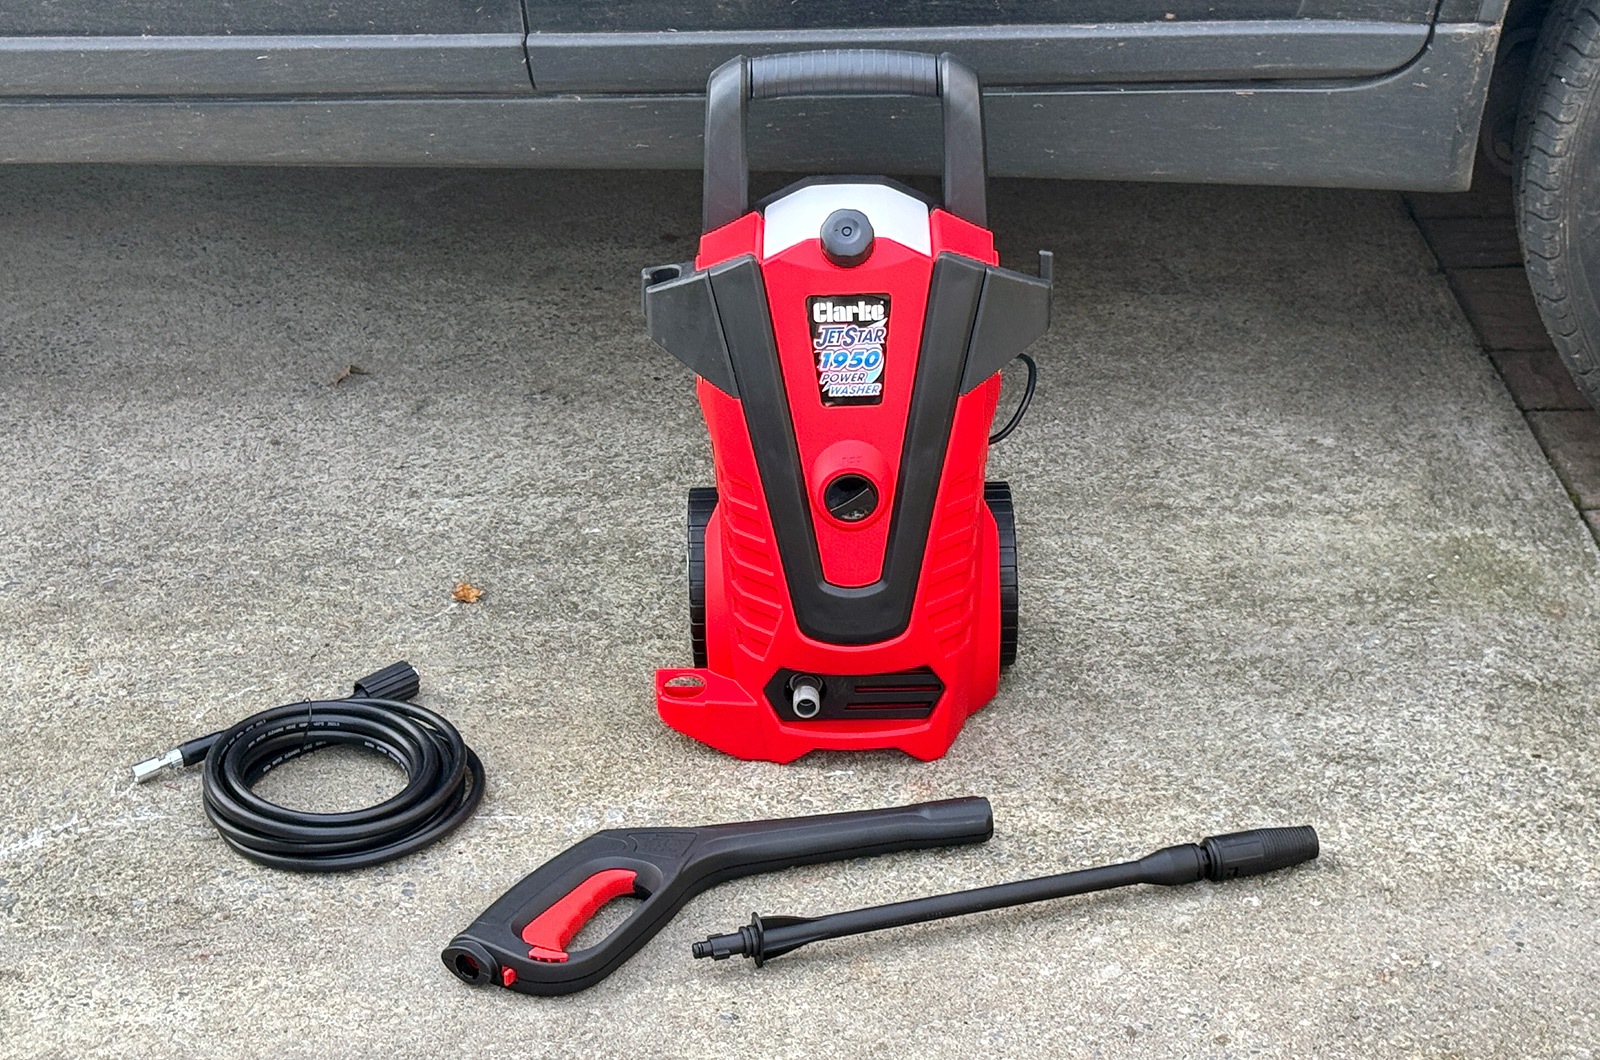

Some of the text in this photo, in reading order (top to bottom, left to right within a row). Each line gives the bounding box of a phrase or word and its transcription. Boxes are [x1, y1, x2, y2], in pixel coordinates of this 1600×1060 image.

[813, 301, 885, 323] Clarke
[821, 350, 880, 369] 1950
[821, 372, 866, 383] POWER
[829, 384, 880, 396] WASHER
